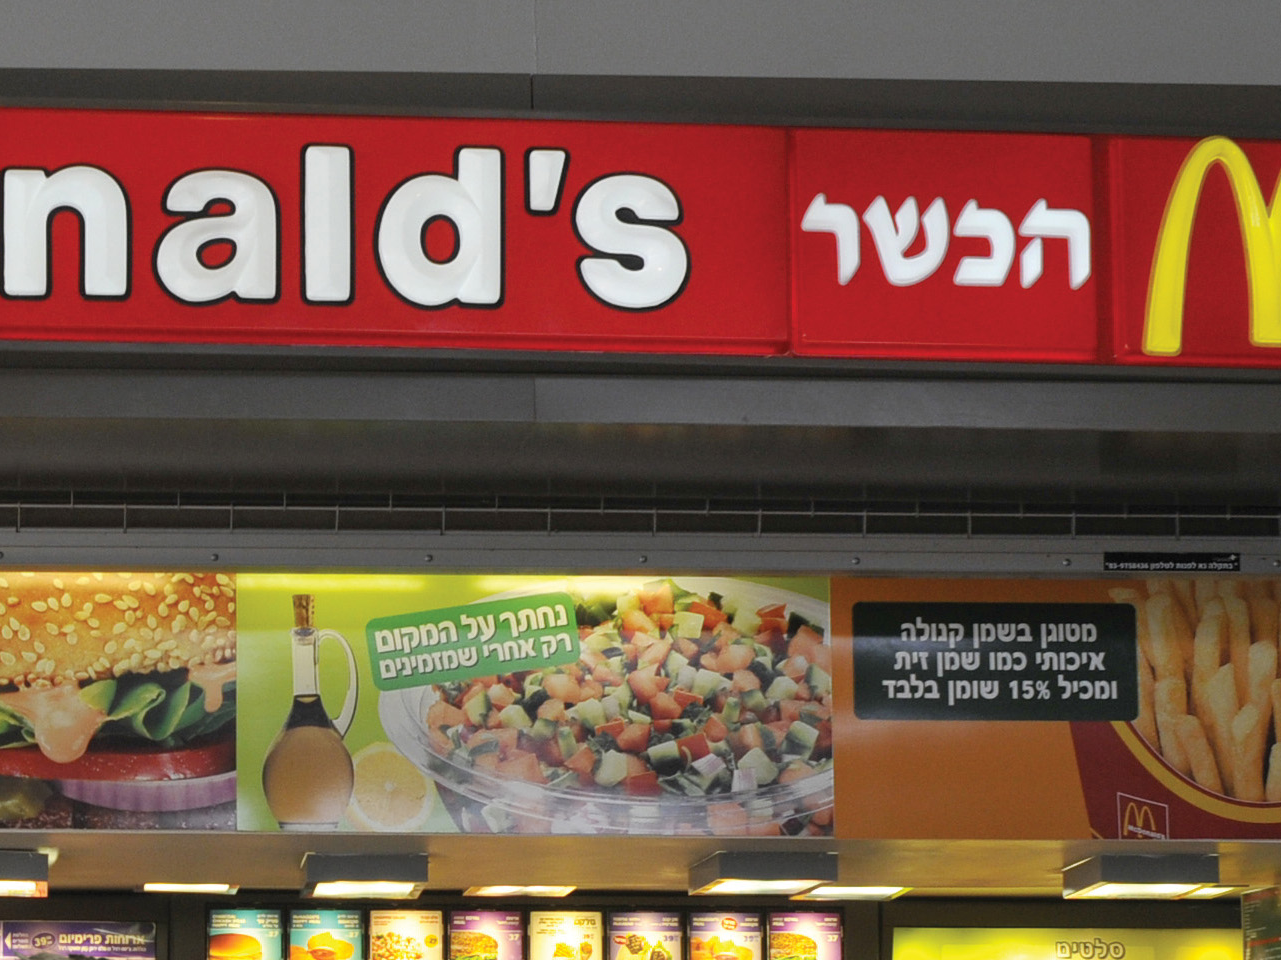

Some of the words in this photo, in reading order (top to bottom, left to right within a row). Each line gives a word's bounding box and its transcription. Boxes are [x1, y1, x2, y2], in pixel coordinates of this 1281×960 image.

[801, 193, 1092, 291] הכשר
[460, 611, 497, 641] על
[499, 603, 568, 634] נחתך
[375, 620, 459, 659] המקום
[541, 632, 572, 659] רק
[900, 617, 964, 648] קנולה
[973, 622, 1033, 648] בשמן
[1040, 622, 1097, 648] מטוגן
[379, 646, 479, 680] שמזמינים
[484, 636, 536, 664] אחרי
[894, 650, 929, 671] זית
[937, 650, 980, 676] שמן
[989, 650, 1027, 671] כמו
[1035, 650, 1106, 671] איכותי
[882, 675, 940, 700] בלבד
[948, 679, 1000, 706] שומן
[1008, 679, 1050, 700] 15%
[1060, 675, 1118, 700] ומכיל
[1055, 938, 1126, 960] סלטים
